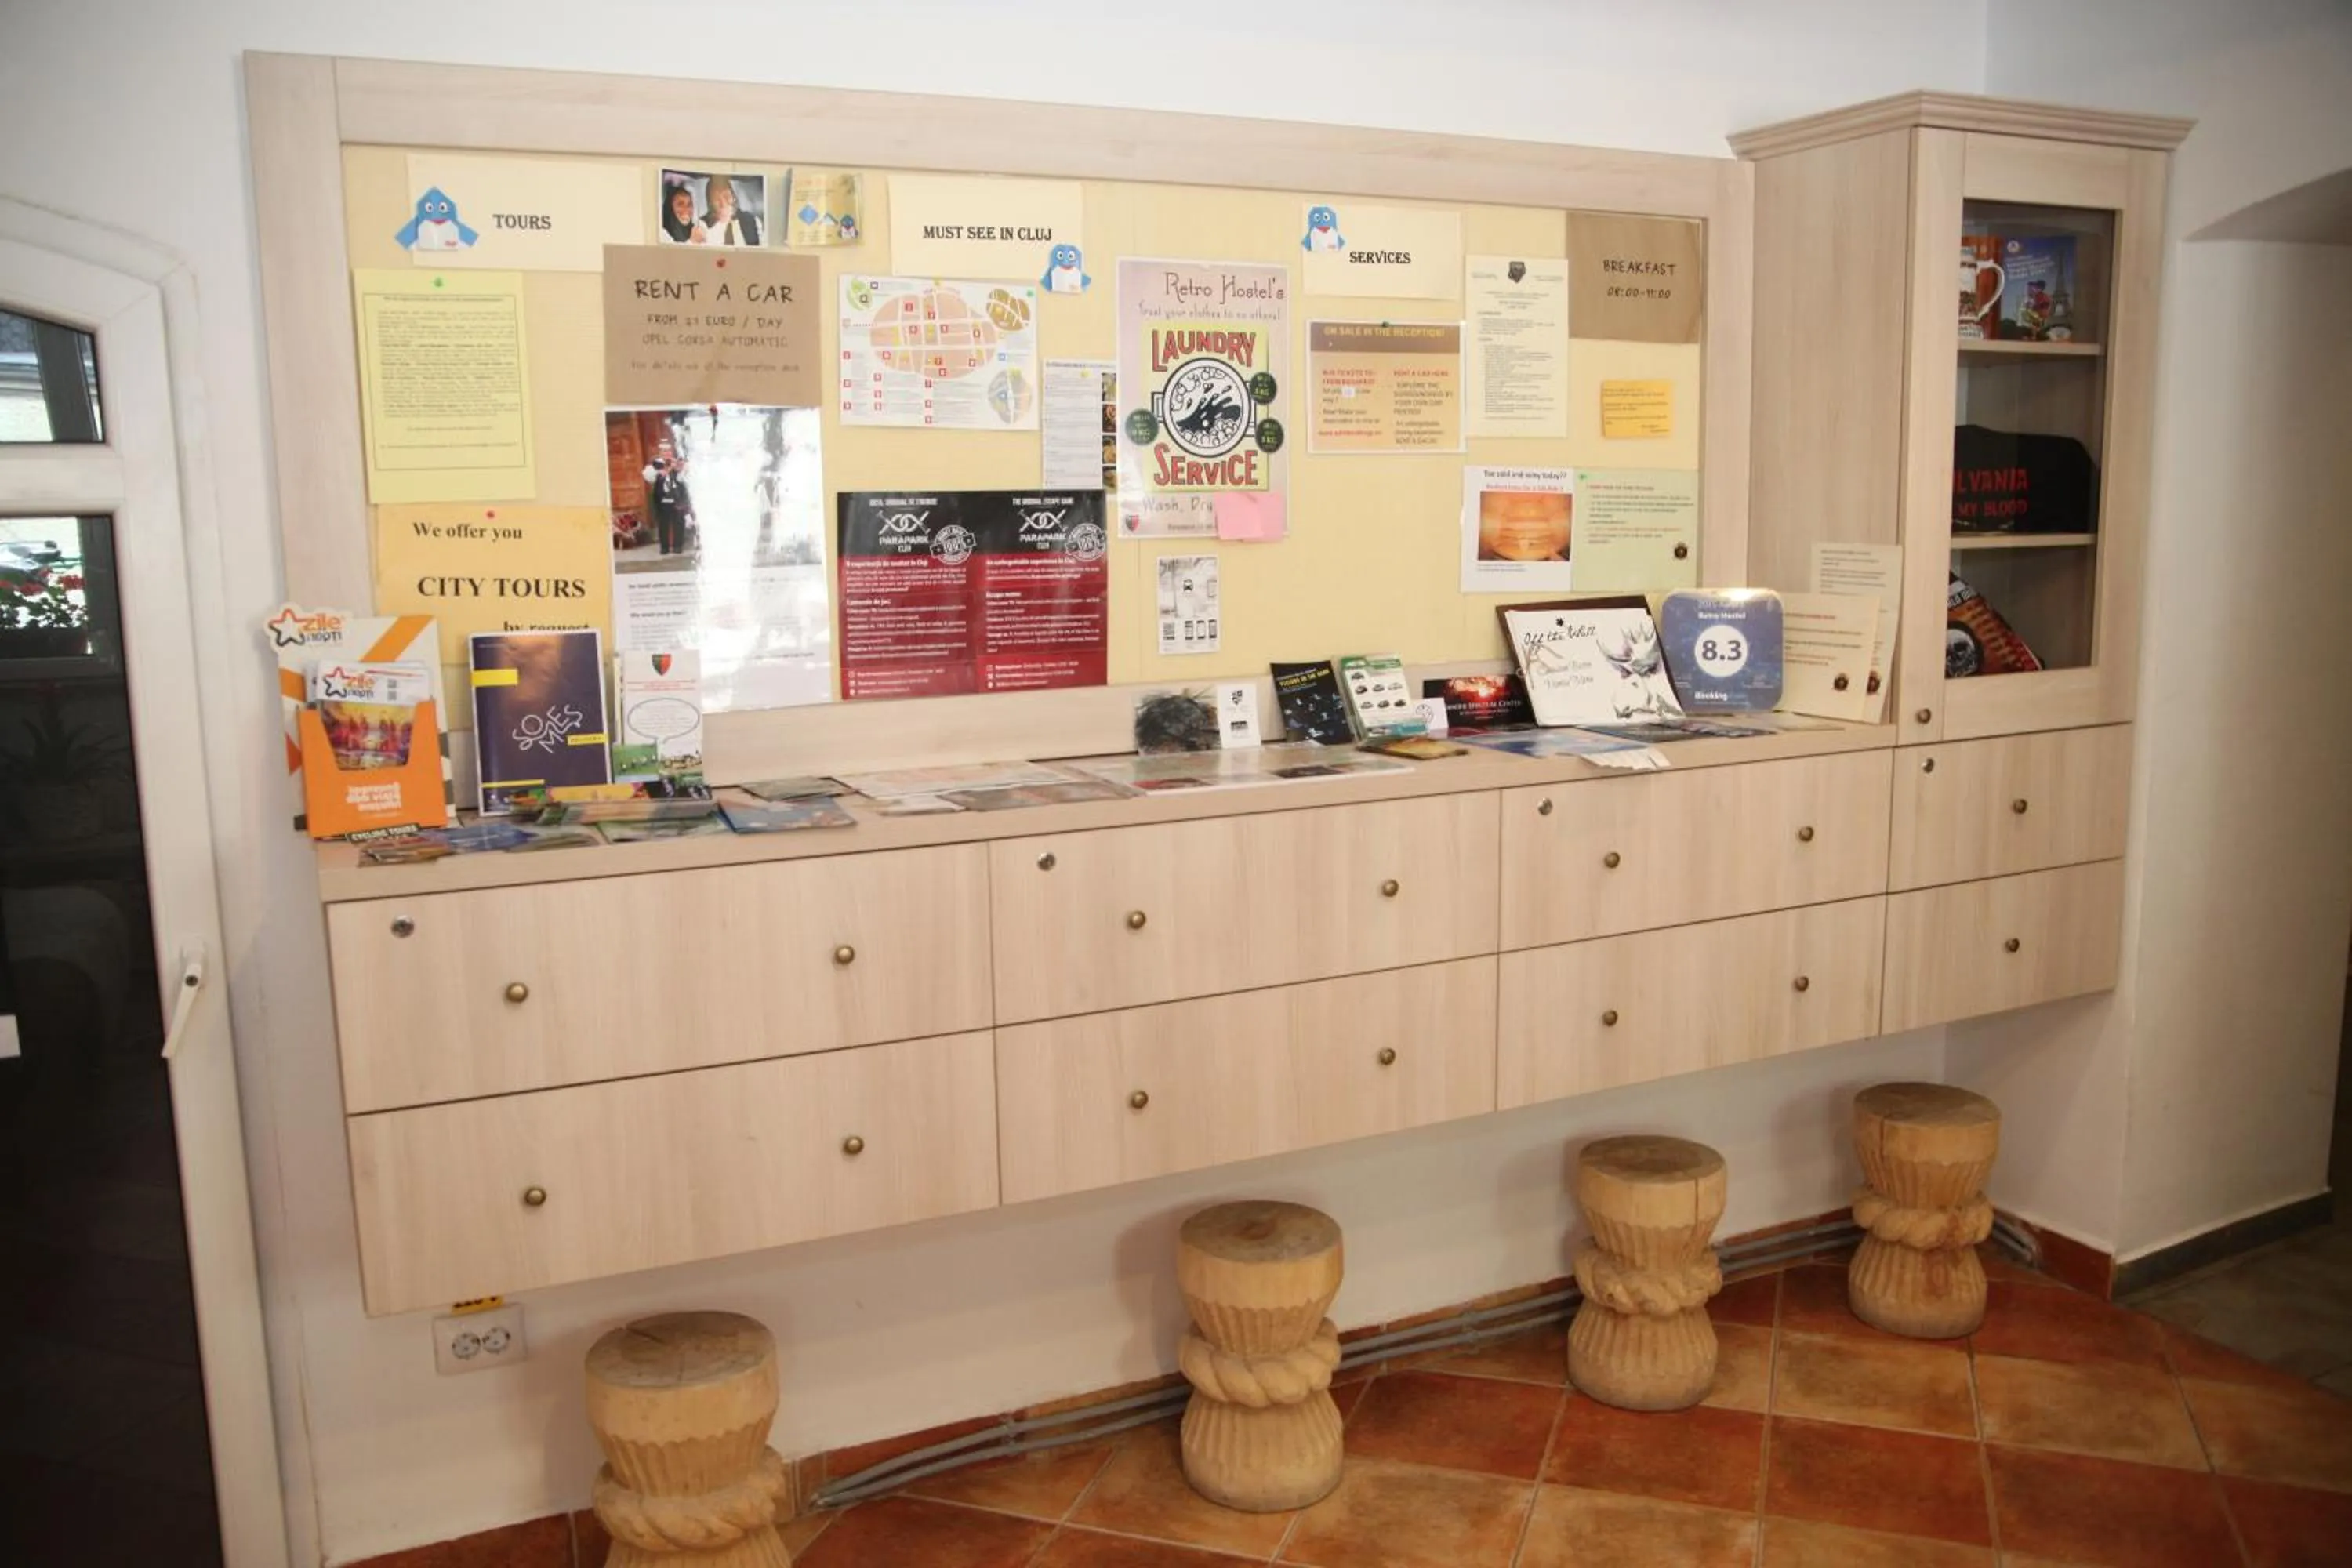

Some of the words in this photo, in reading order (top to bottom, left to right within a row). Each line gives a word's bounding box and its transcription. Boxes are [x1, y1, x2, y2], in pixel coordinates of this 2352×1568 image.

[493, 214, 552, 230] TOURS
[923, 226, 964, 239] MUST
[967, 227, 996, 239] SEE
[1000, 228, 1014, 240] IN
[1017, 227, 1052, 241] CLUJ
[1349, 251, 1411, 264] SERVICES
[1603, 260, 1677, 276] BREAKFAST
[634, 279, 699, 301] RENT
[717, 283, 731, 301] A
[747, 284, 793, 303] CAR
[1165, 272, 1213, 303] Retro
[1219, 274, 1284, 304] Hostel's
[648, 314, 678, 326] FROM
[706, 315, 735, 327] EURO
[757, 318, 783, 329] DAY
[1339, 327, 1361, 336] SALE
[642, 334, 669, 345] OPEL
[721, 336, 789, 348] AUTOMATIC
[1152, 328, 1257, 372] LAUNDRY
[1153, 442, 1258, 486] SERVICE
[413, 522, 441, 538] We
[446, 522, 487, 539] offer
[492, 528, 523, 543] you
[879, 535, 929, 545] PARAPARK
[1019, 533, 1067, 542] PARAPARK
[418, 577, 485, 597] CITY
[495, 578, 586, 598] TOURS
[1702, 640, 1742, 661] 8.3
[389, 824, 419, 836] TOURS
